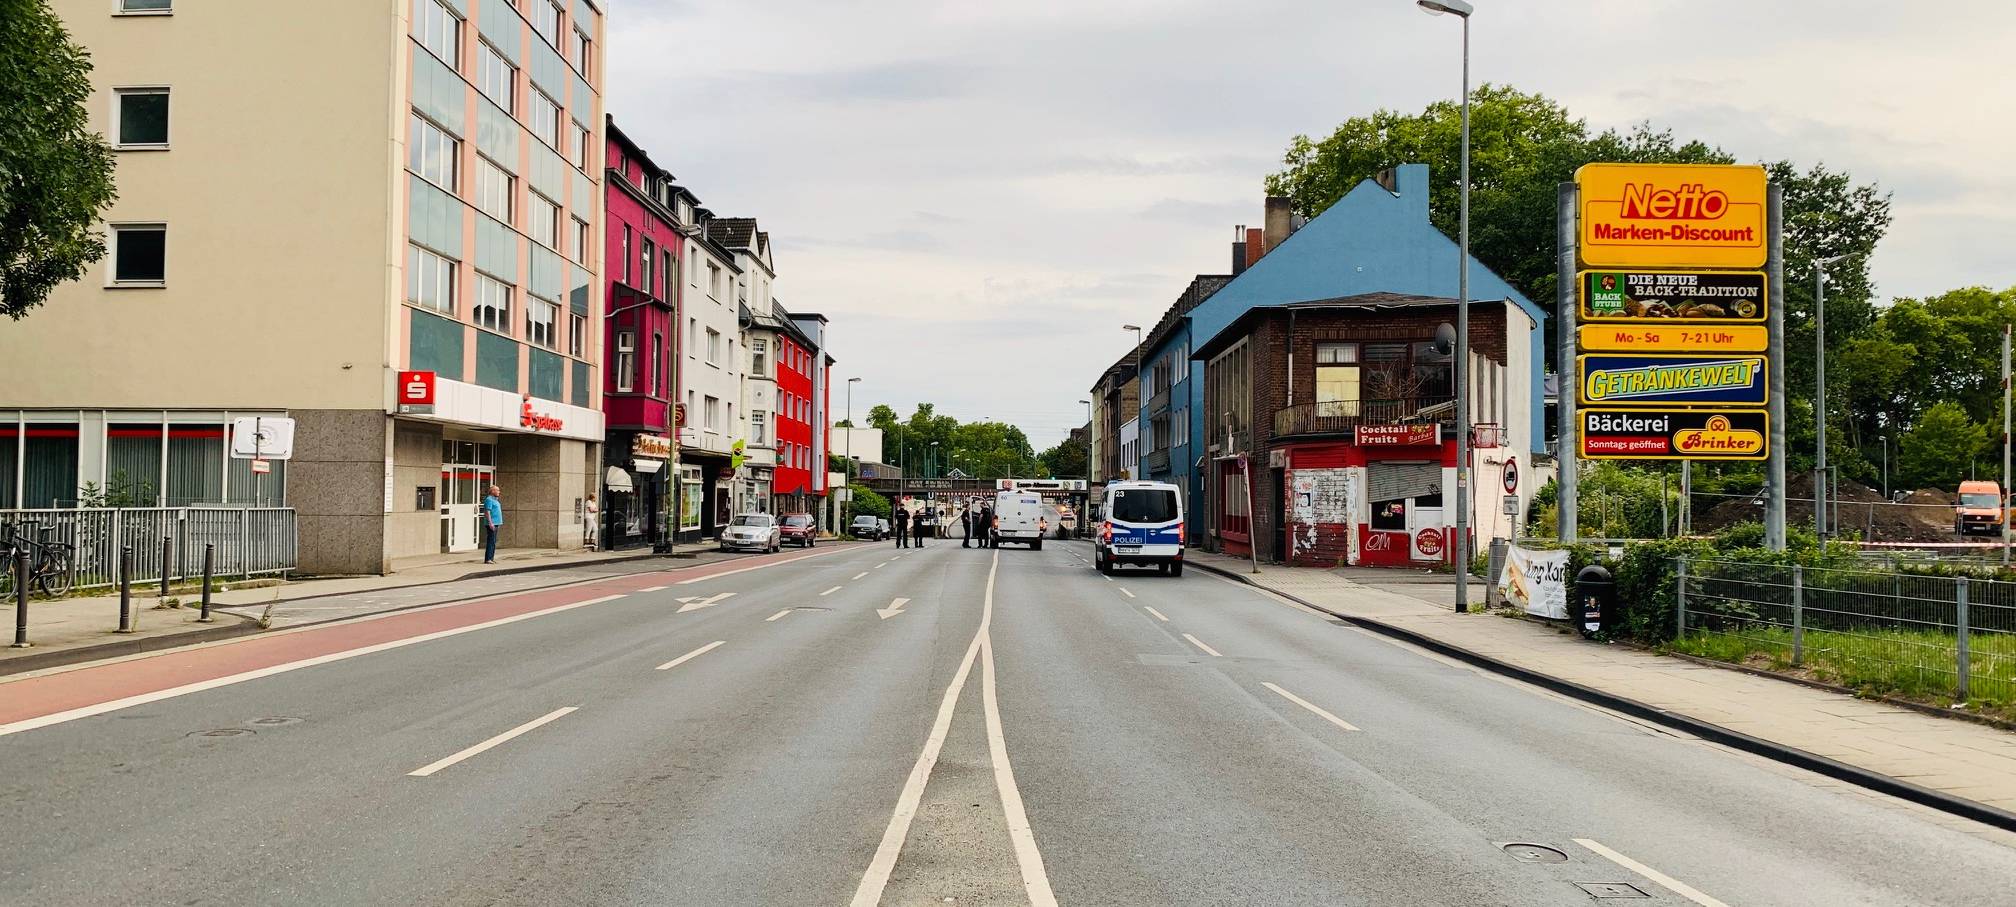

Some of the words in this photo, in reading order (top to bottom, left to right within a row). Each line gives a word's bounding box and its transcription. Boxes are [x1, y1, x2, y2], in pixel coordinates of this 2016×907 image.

[1620, 183, 1729, 219] Netto
[1594, 223, 1754, 241] Marken-Discount
[1628, 275, 1654, 285] DIE
[1656, 275, 1698, 286] NEUE
[1634, 286, 1759, 297] BACK-TRADITION
[1615, 333, 1634, 343] Mo
[1645, 333, 1660, 343] Sa
[1713, 333, 1734, 343] Uhr
[1589, 360, 1759, 400] GETRÄNKEWELT
[1360, 425, 1408, 433] Cocktail
[1588, 415, 1669, 432] Bäckerei
[1361, 435, 1398, 443] Fruits
[1682, 432, 1755, 450] Brinker
[1588, 440, 1627, 449] Sonntags
[1629, 440, 1666, 450] geöffnet
